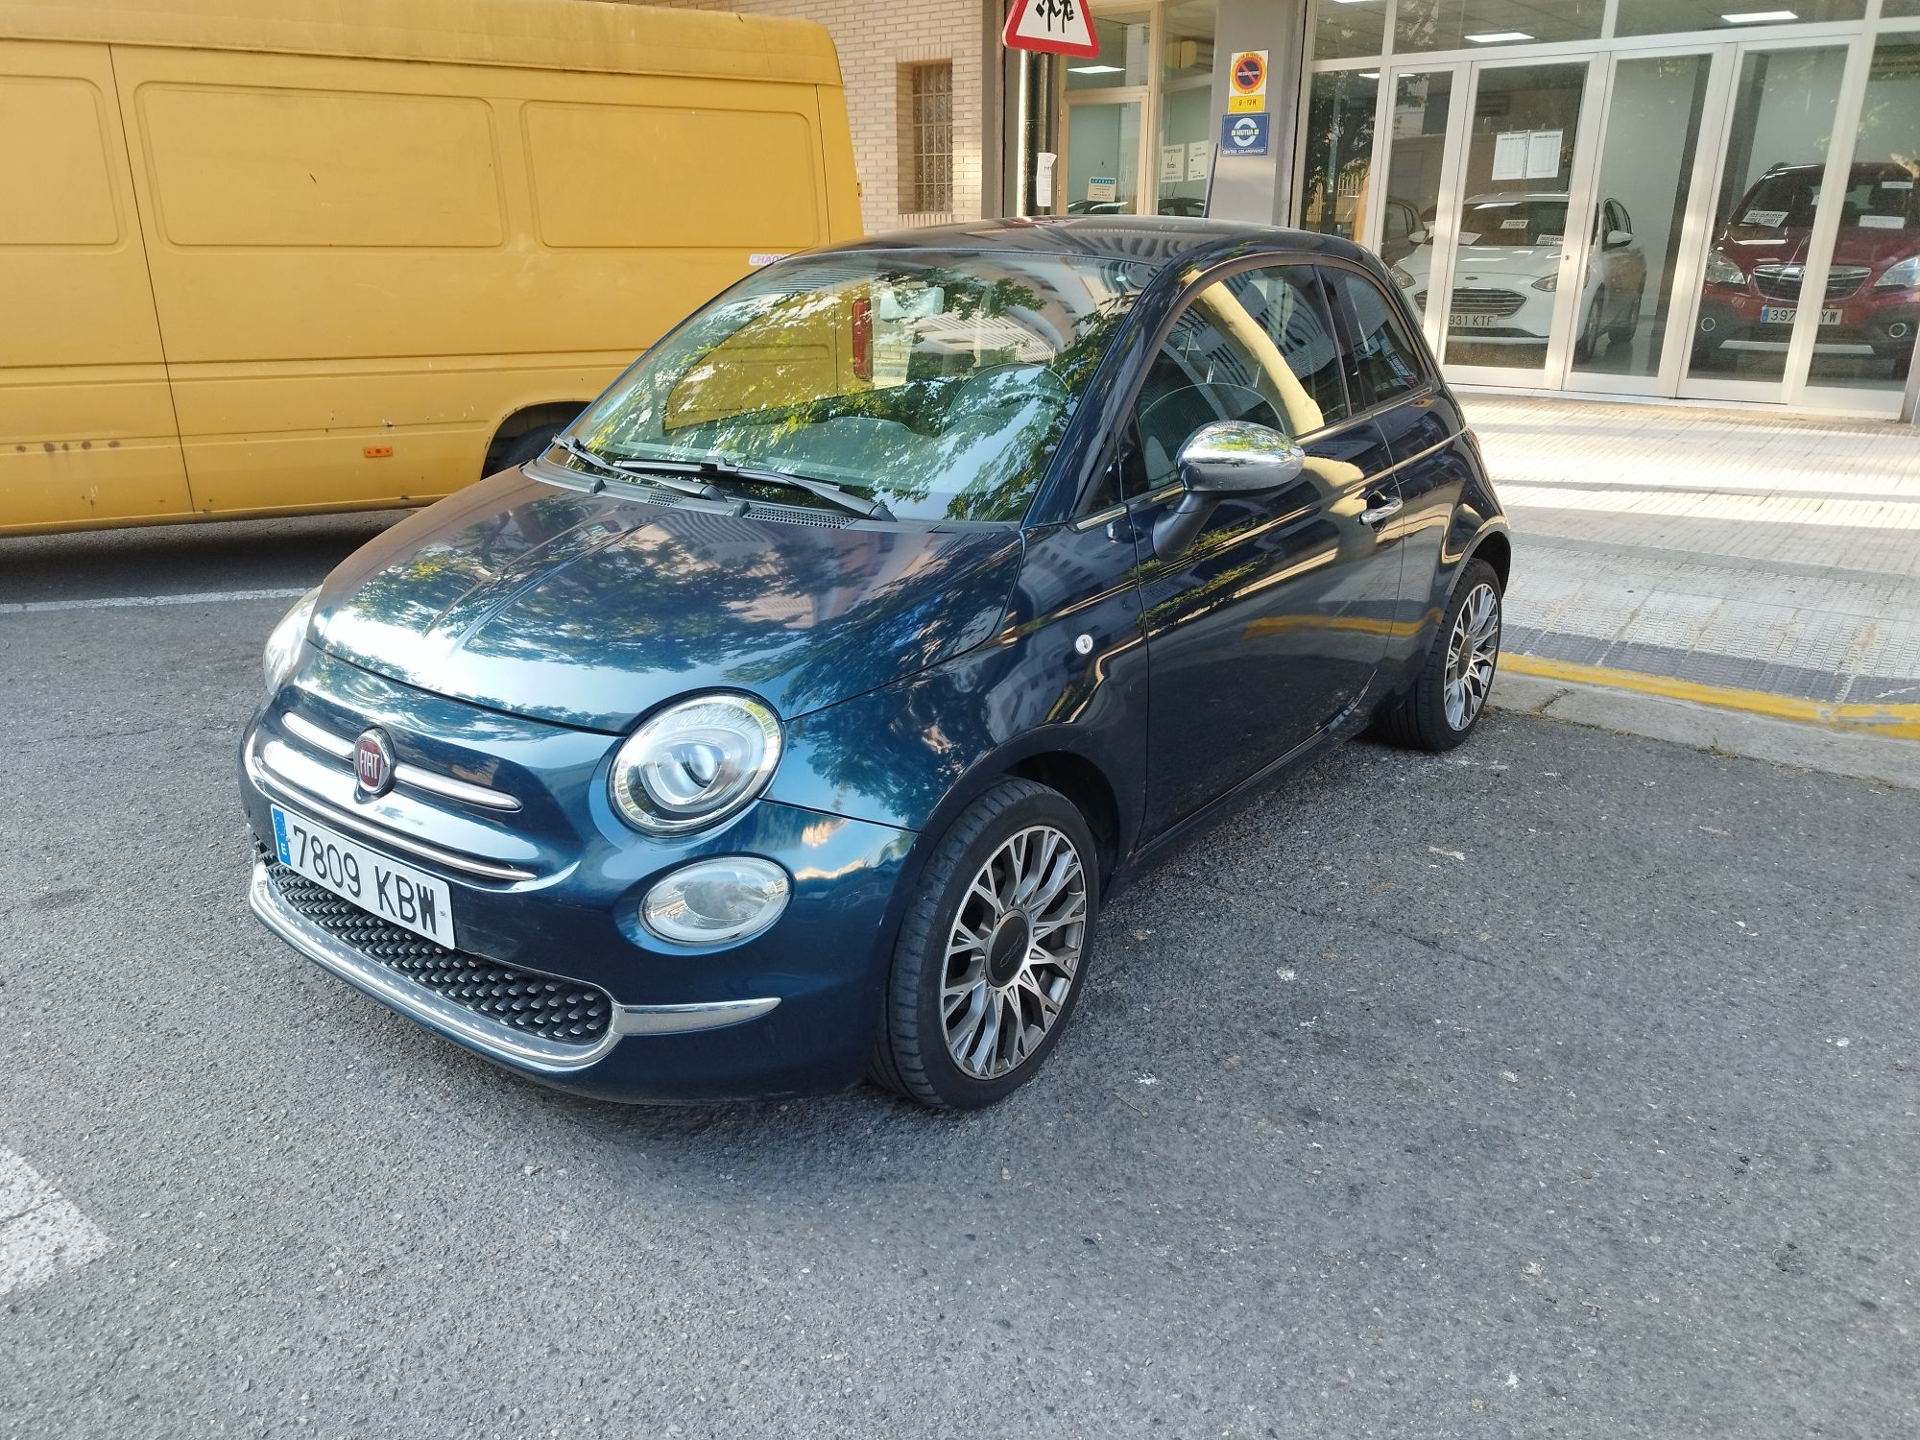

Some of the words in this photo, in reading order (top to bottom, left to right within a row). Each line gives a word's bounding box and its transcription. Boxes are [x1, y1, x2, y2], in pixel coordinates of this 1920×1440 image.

[1449, 314, 1469, 327] 931
[1472, 315, 1495, 327] KTF
[1770, 309, 1797, 322] 397
[1820, 310, 1838, 324] YW
[359, 748, 380, 780] FIAT
[293, 824, 361, 899] 7809
[374, 865, 437, 935] KBW
